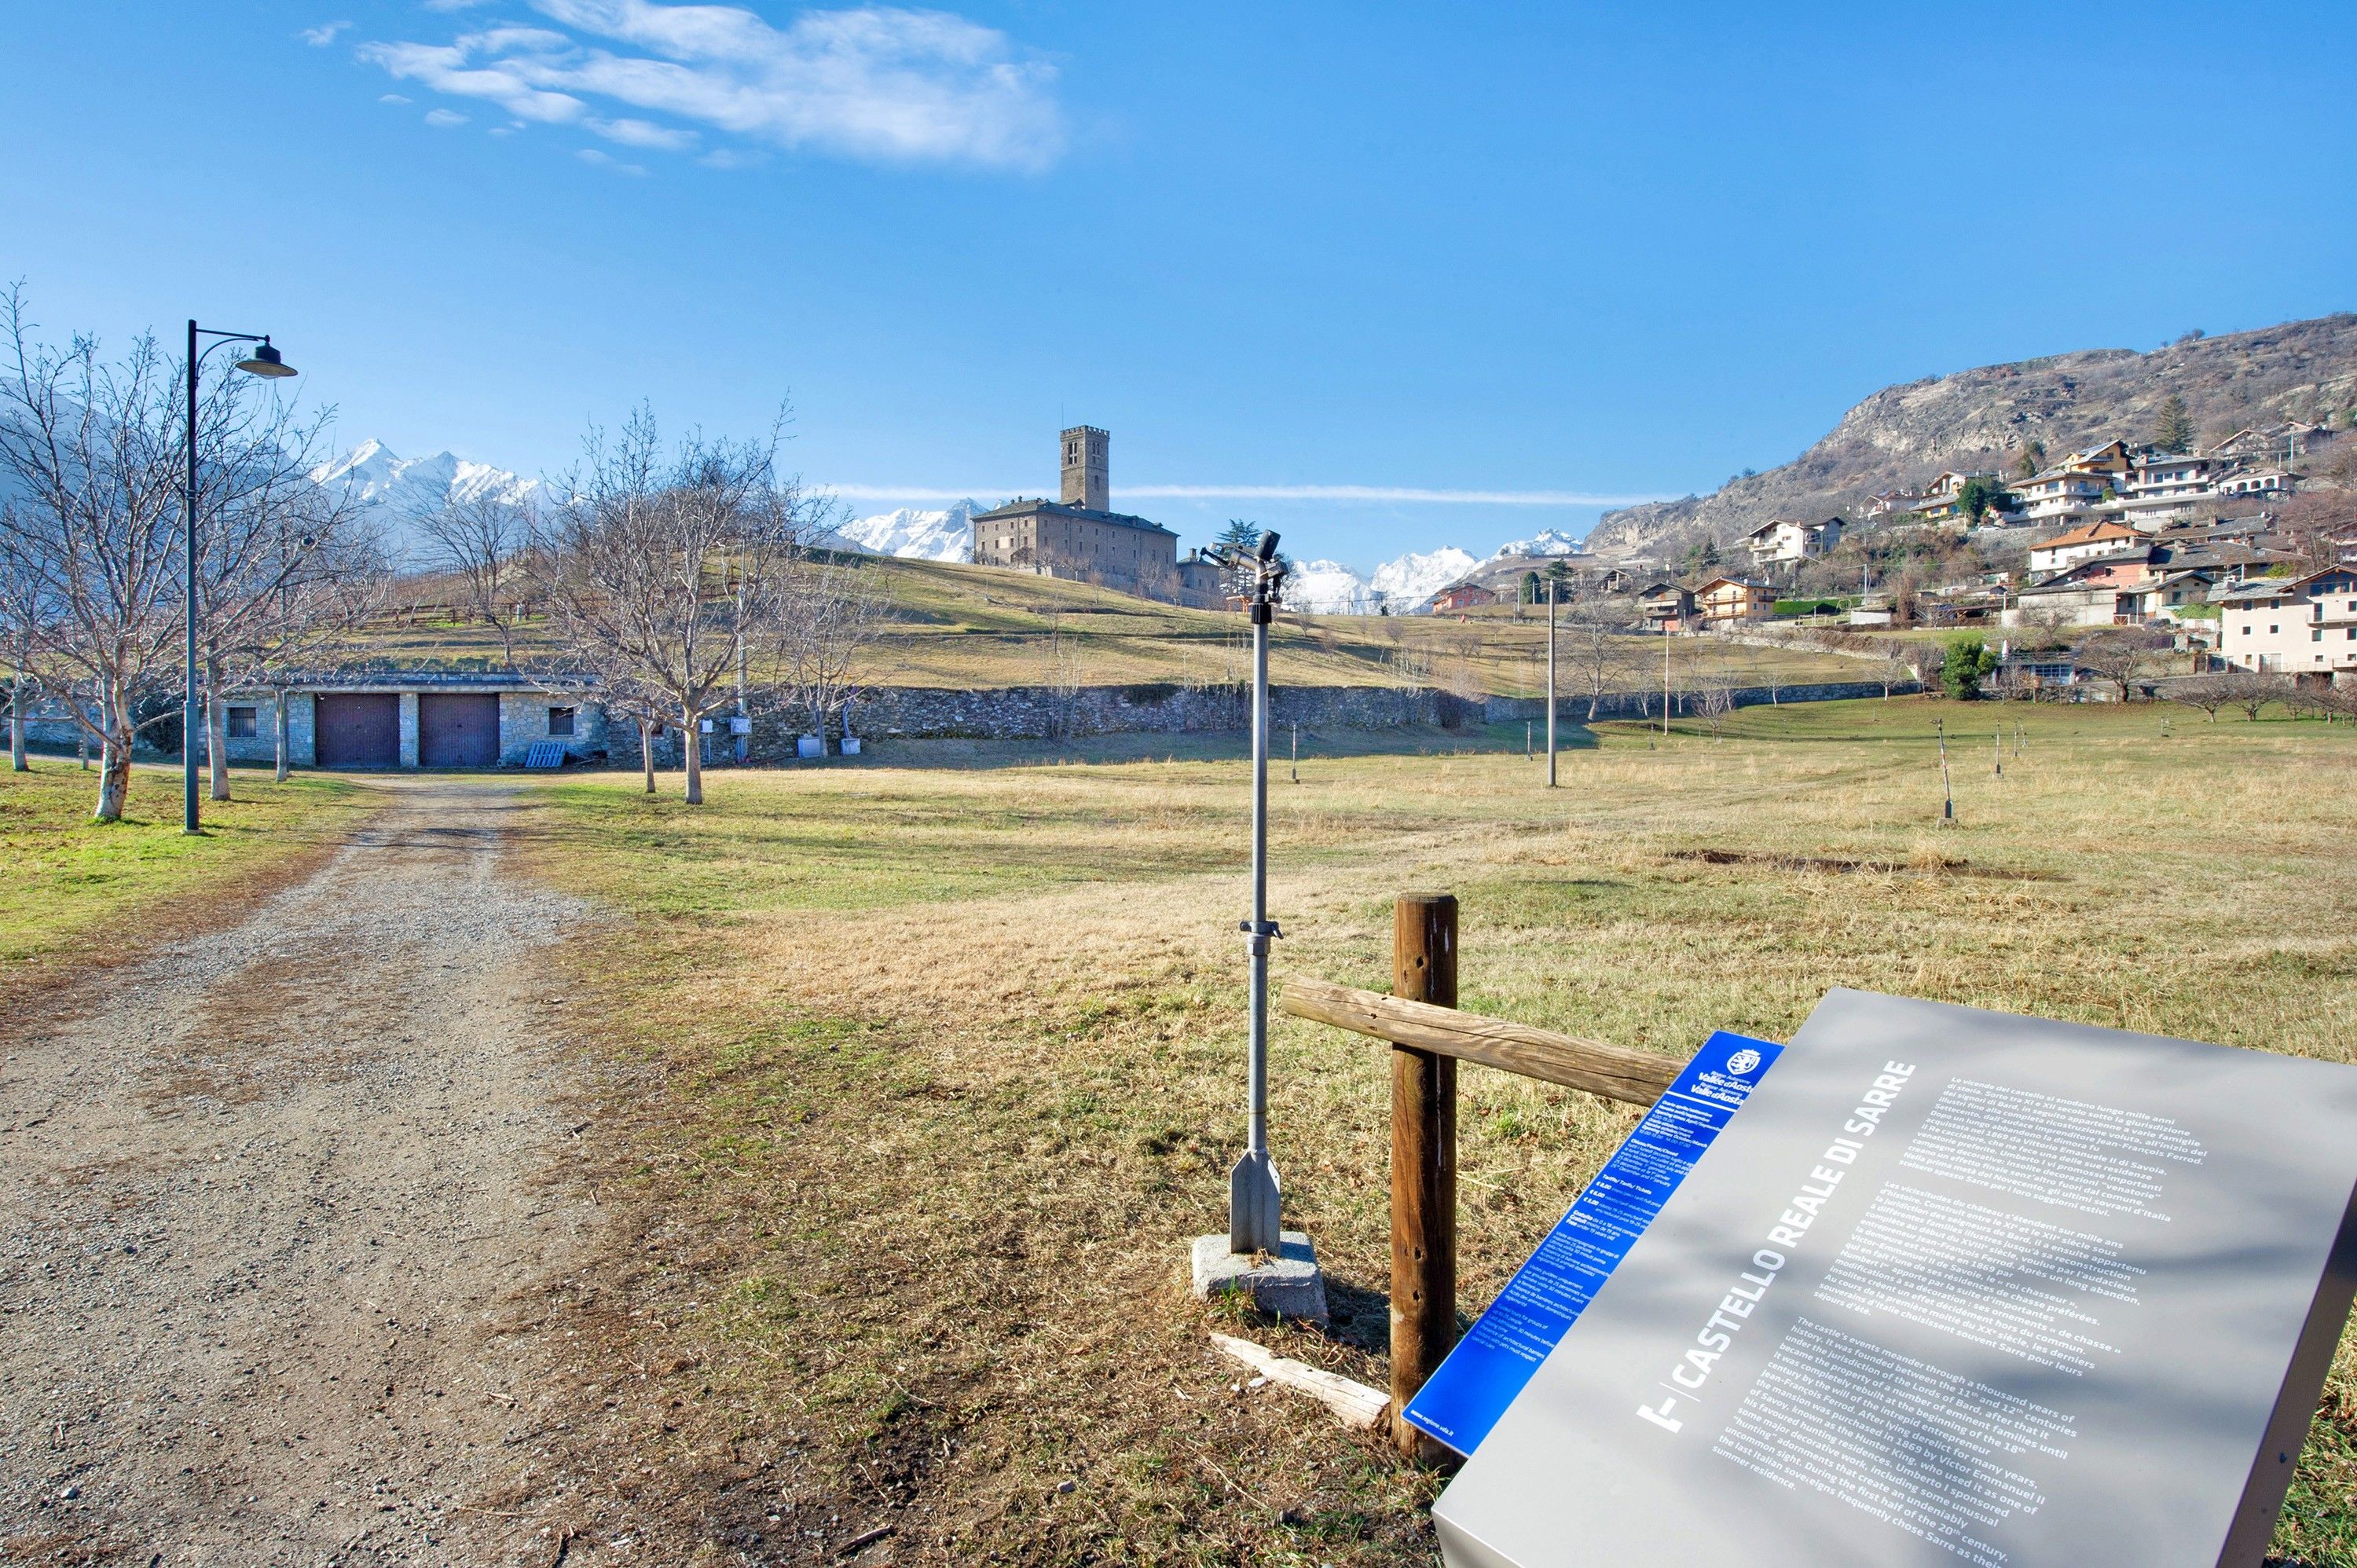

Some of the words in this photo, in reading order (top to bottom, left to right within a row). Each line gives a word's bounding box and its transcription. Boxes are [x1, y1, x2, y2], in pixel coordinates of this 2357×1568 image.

[1690, 1084, 1713, 1097] Valle
[1710, 1090, 1747, 1105] d'Aosta
[1698, 1072, 1725, 1086] Vallée
[1963, 1079, 1994, 1089] vicende
[2011, 1090, 2044, 1099] castello
[2056, 1098, 2095, 1109] snodano
[2096, 1105, 2124, 1115] lungo
[1934, 1103, 1981, 1118] Settecento,
[1983, 1114, 2033, 1128] dall'audace
[2034, 1125, 2095, 1141] imprenditore
[2095, 1138, 2164, 1156] Jean-François
[2166, 1152, 2202, 1165] Ferrod.
[1938, 1096, 1966, 1106] illustri
[2003, 1111, 2044, 1123] completa
[2045, 1119, 2106, 1136] ricostruzione
[2109, 1133, 2141, 1144] voluta,
[2145, 1140, 2187, 1152] all'inizio
[1672, 1250, 1786, 1389] CASTELLO
[1767, 1165, 1846, 1248] REALE
[1824, 1138, 1863, 1165] DI
[1844, 1060, 1915, 1137] SARRE
[1901, 1185, 1951, 1203] vicissitudes
[1966, 1203, 2003, 1217] château
[2004, 1214, 2057, 1231] s'étendent
[2077, 1233, 2102, 1243] mille
[2104, 1240, 2123, 1248] ans
[1903, 1152, 1925, 1161] Nella
[1926, 1159, 1952, 1168] prima
[1953, 1165, 1976, 1174] metà
[1993, 1174, 2044, 1192] Novecento,
[2062, 1192, 2092, 1202] ultimi
[2094, 1200, 2132, 1212] sovrani
[2133, 1208, 2171, 1222] d'Italia
[1876, 1206, 1924, 1223] différentes
[1926, 1218, 1963, 1233] familles
[1964, 1229, 2002, 1245] illustres
[2003, 1240, 2039, 1255] jusqu'à
[2055, 1256, 2131, 1280] reconstruction
[1818, 1283, 1865, 1302] souverains
[1867, 1299, 1899, 1314] d'Italie
[1901, 1311, 1955, 1333] choisissent
[1956, 1330, 1996, 1347] souvent
[1998, 1343, 2025, 1357] Sarre
[2027, 1354, 2053, 1366] pour
[2055, 1361, 2082, 1376] leurs
[1829, 1265, 1866, 1282] insolites
[1868, 1280, 1896, 1292] créent
[1911, 1294, 1934, 1305] effet
[1935, 1301, 1993, 1324] décidément
[1995, 1319, 2018, 1332] hors
[2019, 1328, 2033, 1337] du
[2035, 1334, 2085, 1354] commun.
[1785, 1335, 1811, 1348] under
[1812, 1345, 1827, 1354] the
[1827, 1350, 1880, 1376] jurisdiction
[1894, 1376, 1910, 1387] the
[1912, 1383, 1940, 1398] Lords
[1956, 1398, 1981, 1415] Bard,
[1985, 1412, 2012, 1425] after
[2014, 1421, 2037, 1435] that
[2040, 1430, 2048, 1439] it
[1791, 1324, 1822, 1342] history.
[1834, 1343, 1852, 1353] was
[1854, 1349, 1893, 1368] founded
[1894, 1364, 1936, 1384] between
[1938, 1381, 1956, 1391] the
[1979, 1397, 2000, 1408] and
[2024, 1414, 2077, 1437] centuries
[1798, 1316, 1813, 1327] The
[1814, 1324, 1848, 1340] castle's
[1849, 1337, 1879, 1352] events
[1881, 1350, 1924, 1368] meander
[1926, 1365, 1965, 1383] through
[1976, 1383, 2027, 1405] thousand
[2029, 1402, 2058, 1417] years
[1410, 1409, 1453, 1436] www.regione.vda.it
[1760, 1369, 1821, 1398] Jean-François
[1823, 1394, 1855, 1413] Ferrod.
[1857, 1410, 1884, 1424] After
[1885, 1420, 1910, 1437] lying
[1912, 1432, 1951, 1453] derelict
[1953, 1448, 1969, 1459] for
[1970, 1456, 2003, 1474] many
[2004, 1470, 2036, 1489] years,
[1737, 1408, 1761, 1421] some
[1762, 1419, 1789, 1434] major
[1791, 1431, 1839, 1456] decorative
[1841, 1453, 1867, 1471] work,
[1870, 1465, 1919, 1493] including
[1920, 1489, 1949, 1505] some
[1952, 1503, 1998, 1526] unusual
[1776, 1438, 1834, 1467] adornments
[1835, 1463, 1857, 1478] that
[1857, 1475, 1889, 1493] create
[1890, 1489, 1904, 1499] an
[1906, 1497, 1967, 1529] undeniably
